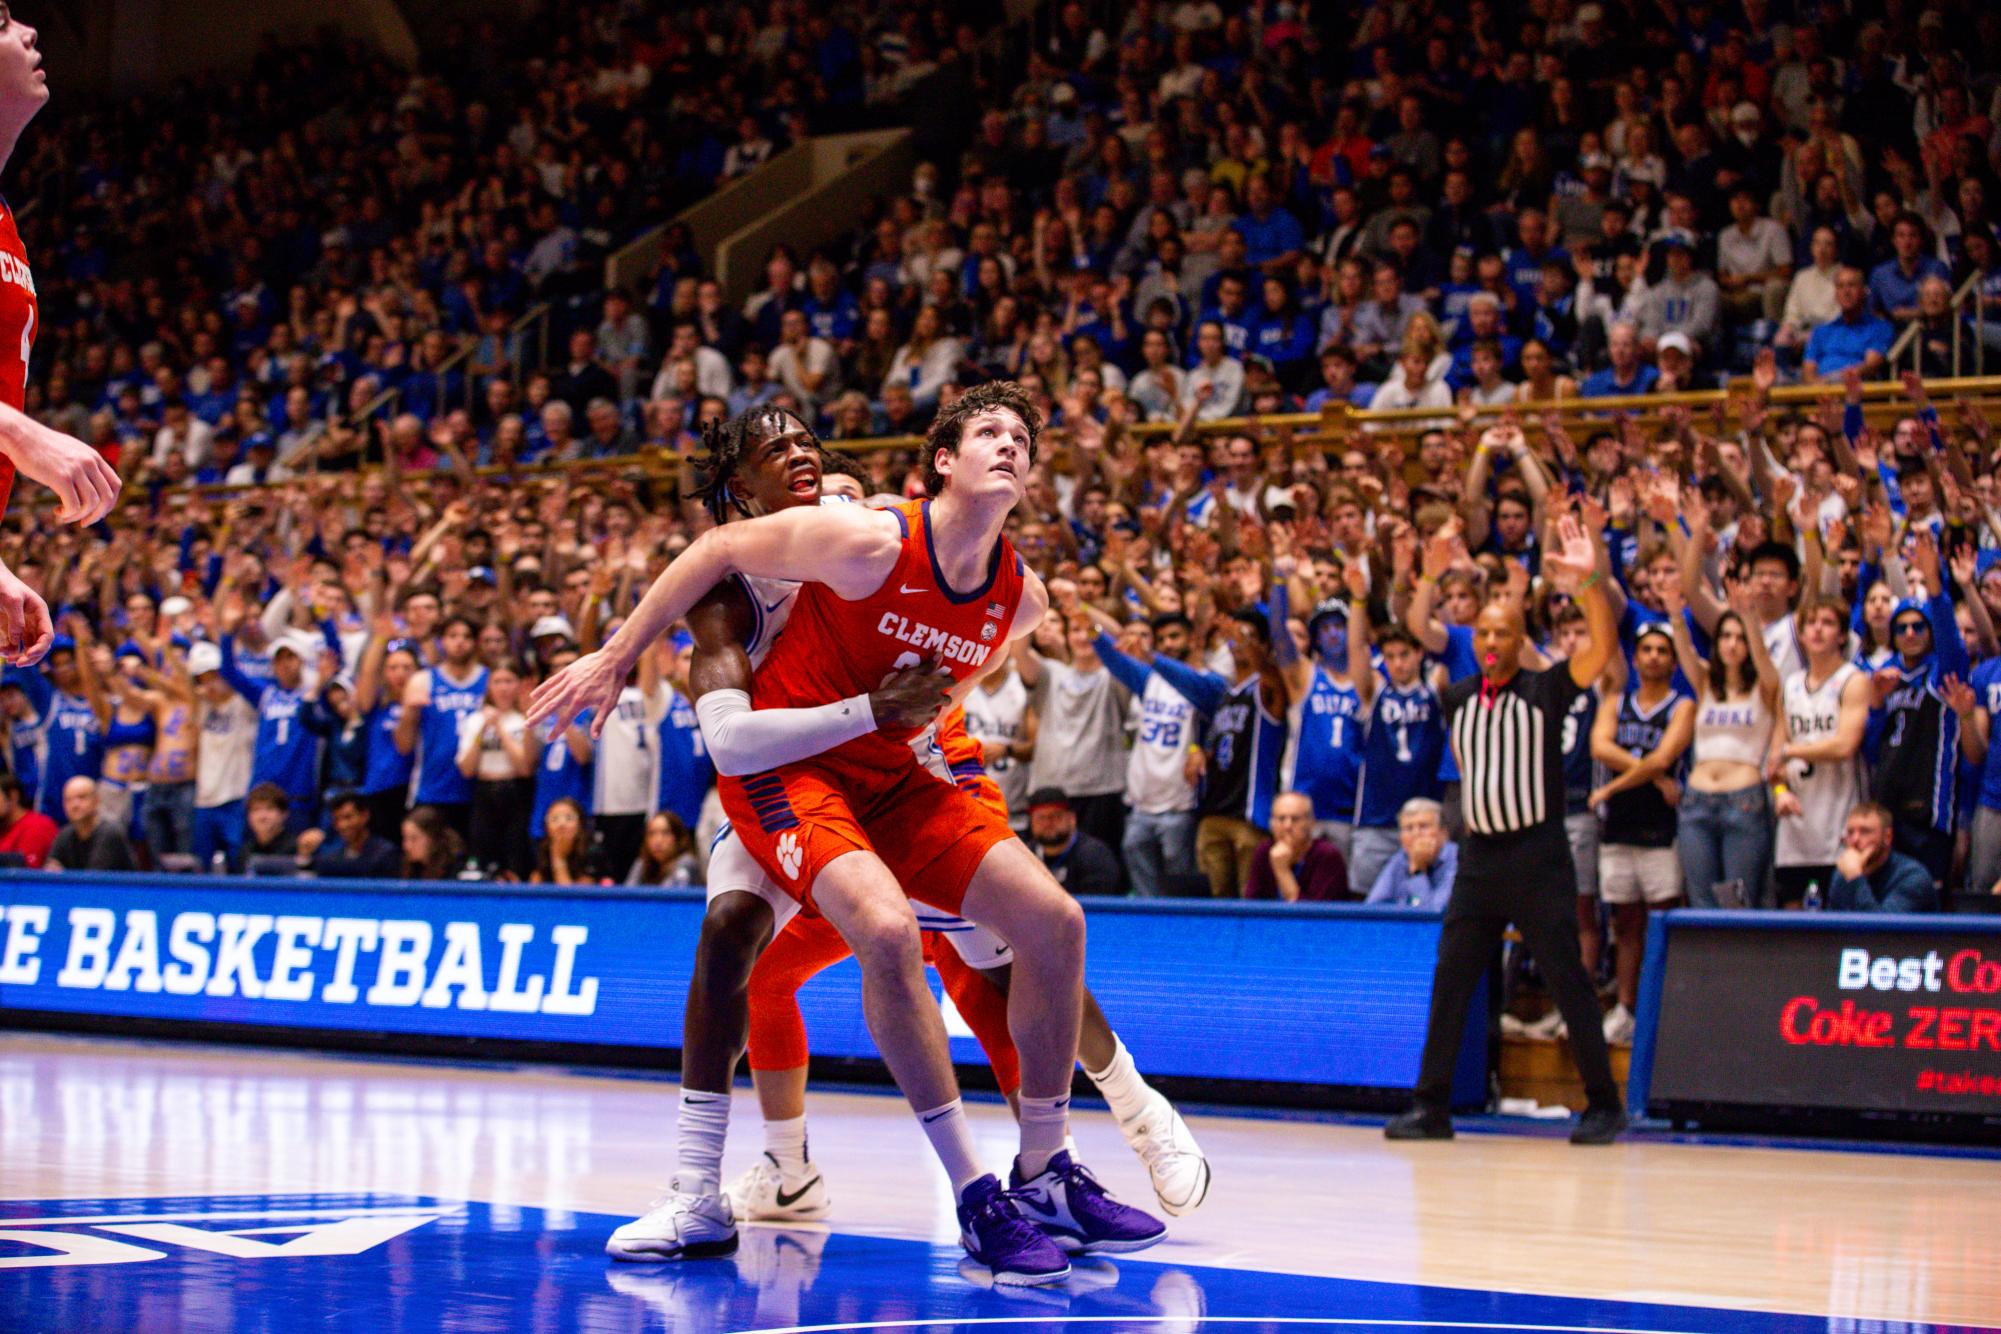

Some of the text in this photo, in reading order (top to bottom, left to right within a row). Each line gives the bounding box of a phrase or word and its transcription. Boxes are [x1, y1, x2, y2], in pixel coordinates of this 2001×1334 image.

[877, 611, 992, 667] CLEMSON
[1140, 717, 1181, 748] 32
[1330, 716, 1344, 749] 1
[1395, 727, 1413, 763] 1
[57, 906, 600, 1017] BASKETBALL
[1838, 947, 1944, 993] Best
[1779, 995, 2001, 1052] Coke ZER
